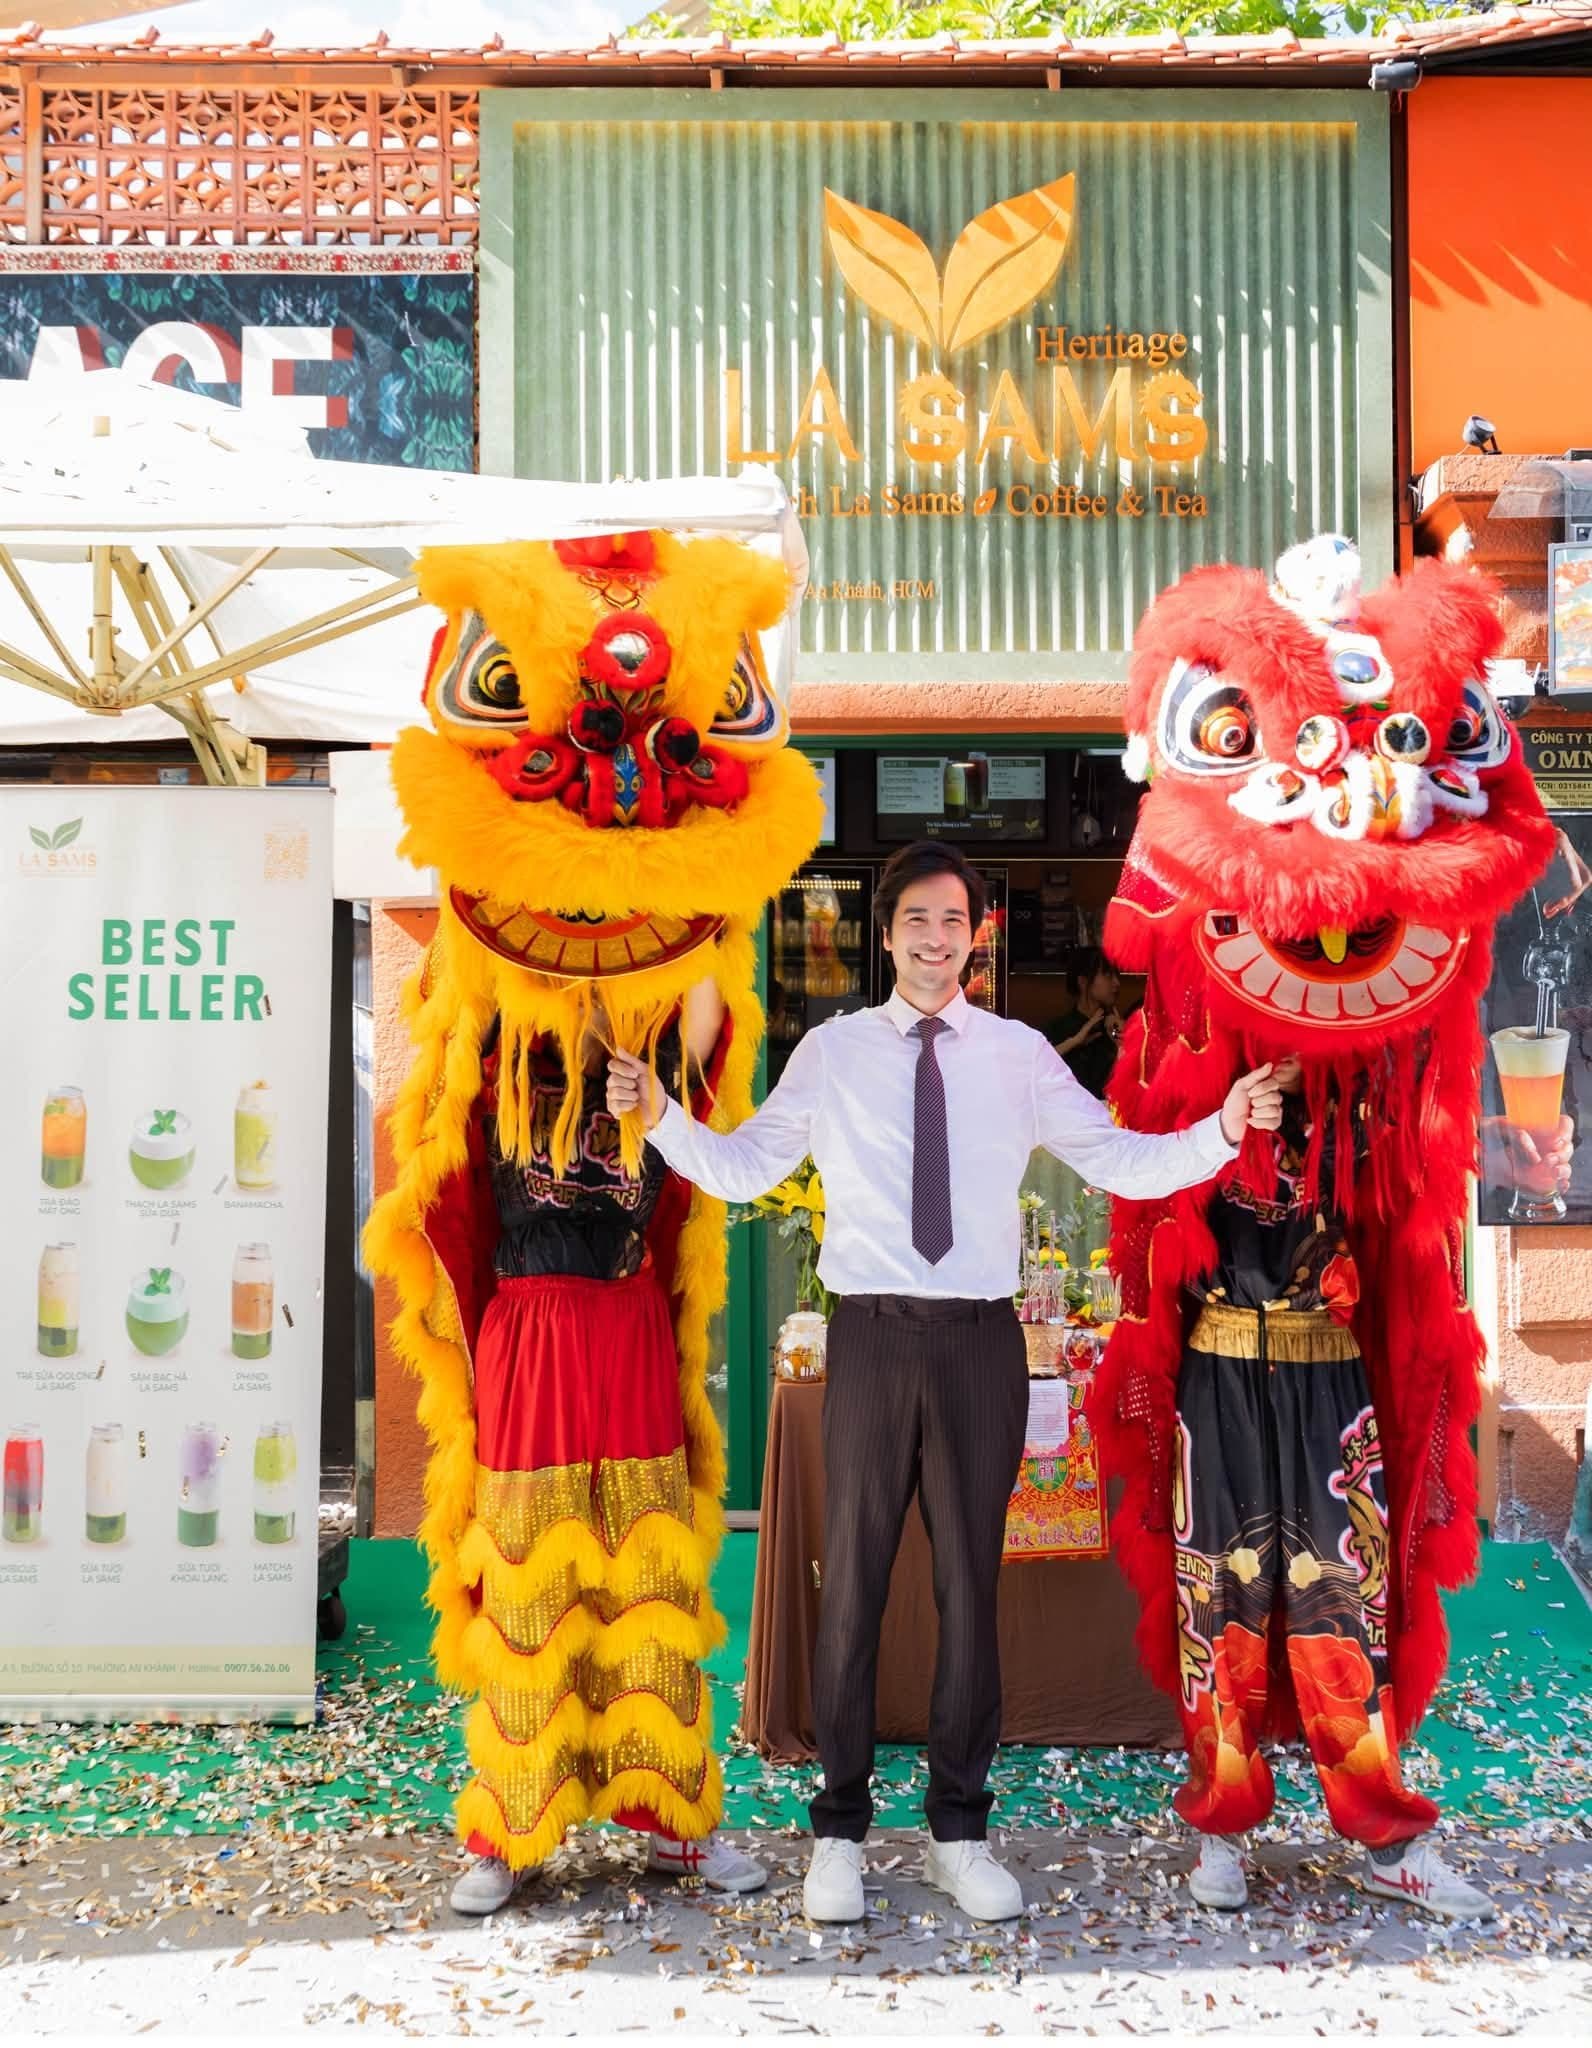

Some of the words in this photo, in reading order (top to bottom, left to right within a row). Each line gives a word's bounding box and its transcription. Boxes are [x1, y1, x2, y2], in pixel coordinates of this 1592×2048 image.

[1037, 326, 1188, 368] Heritage
[724, 366, 860, 463] LA
[899, 366, 1209, 465] SAMS
[831, 486, 872, 517] La
[880, 484, 965, 517] Sams
[1006, 485, 1106, 517] Coffee
[1115, 487, 1145, 517] &
[1153, 487, 1208, 517] Tea
[893, 580, 935, 600] HCM
[1530, 730, 1565, 745] CÔNG
[1566, 732, 1583, 745] TY
[102, 919, 236, 966] BEST
[68, 972, 265, 1021] SELLER
[224, 1663, 290, 1673] 0907.56.26.06
